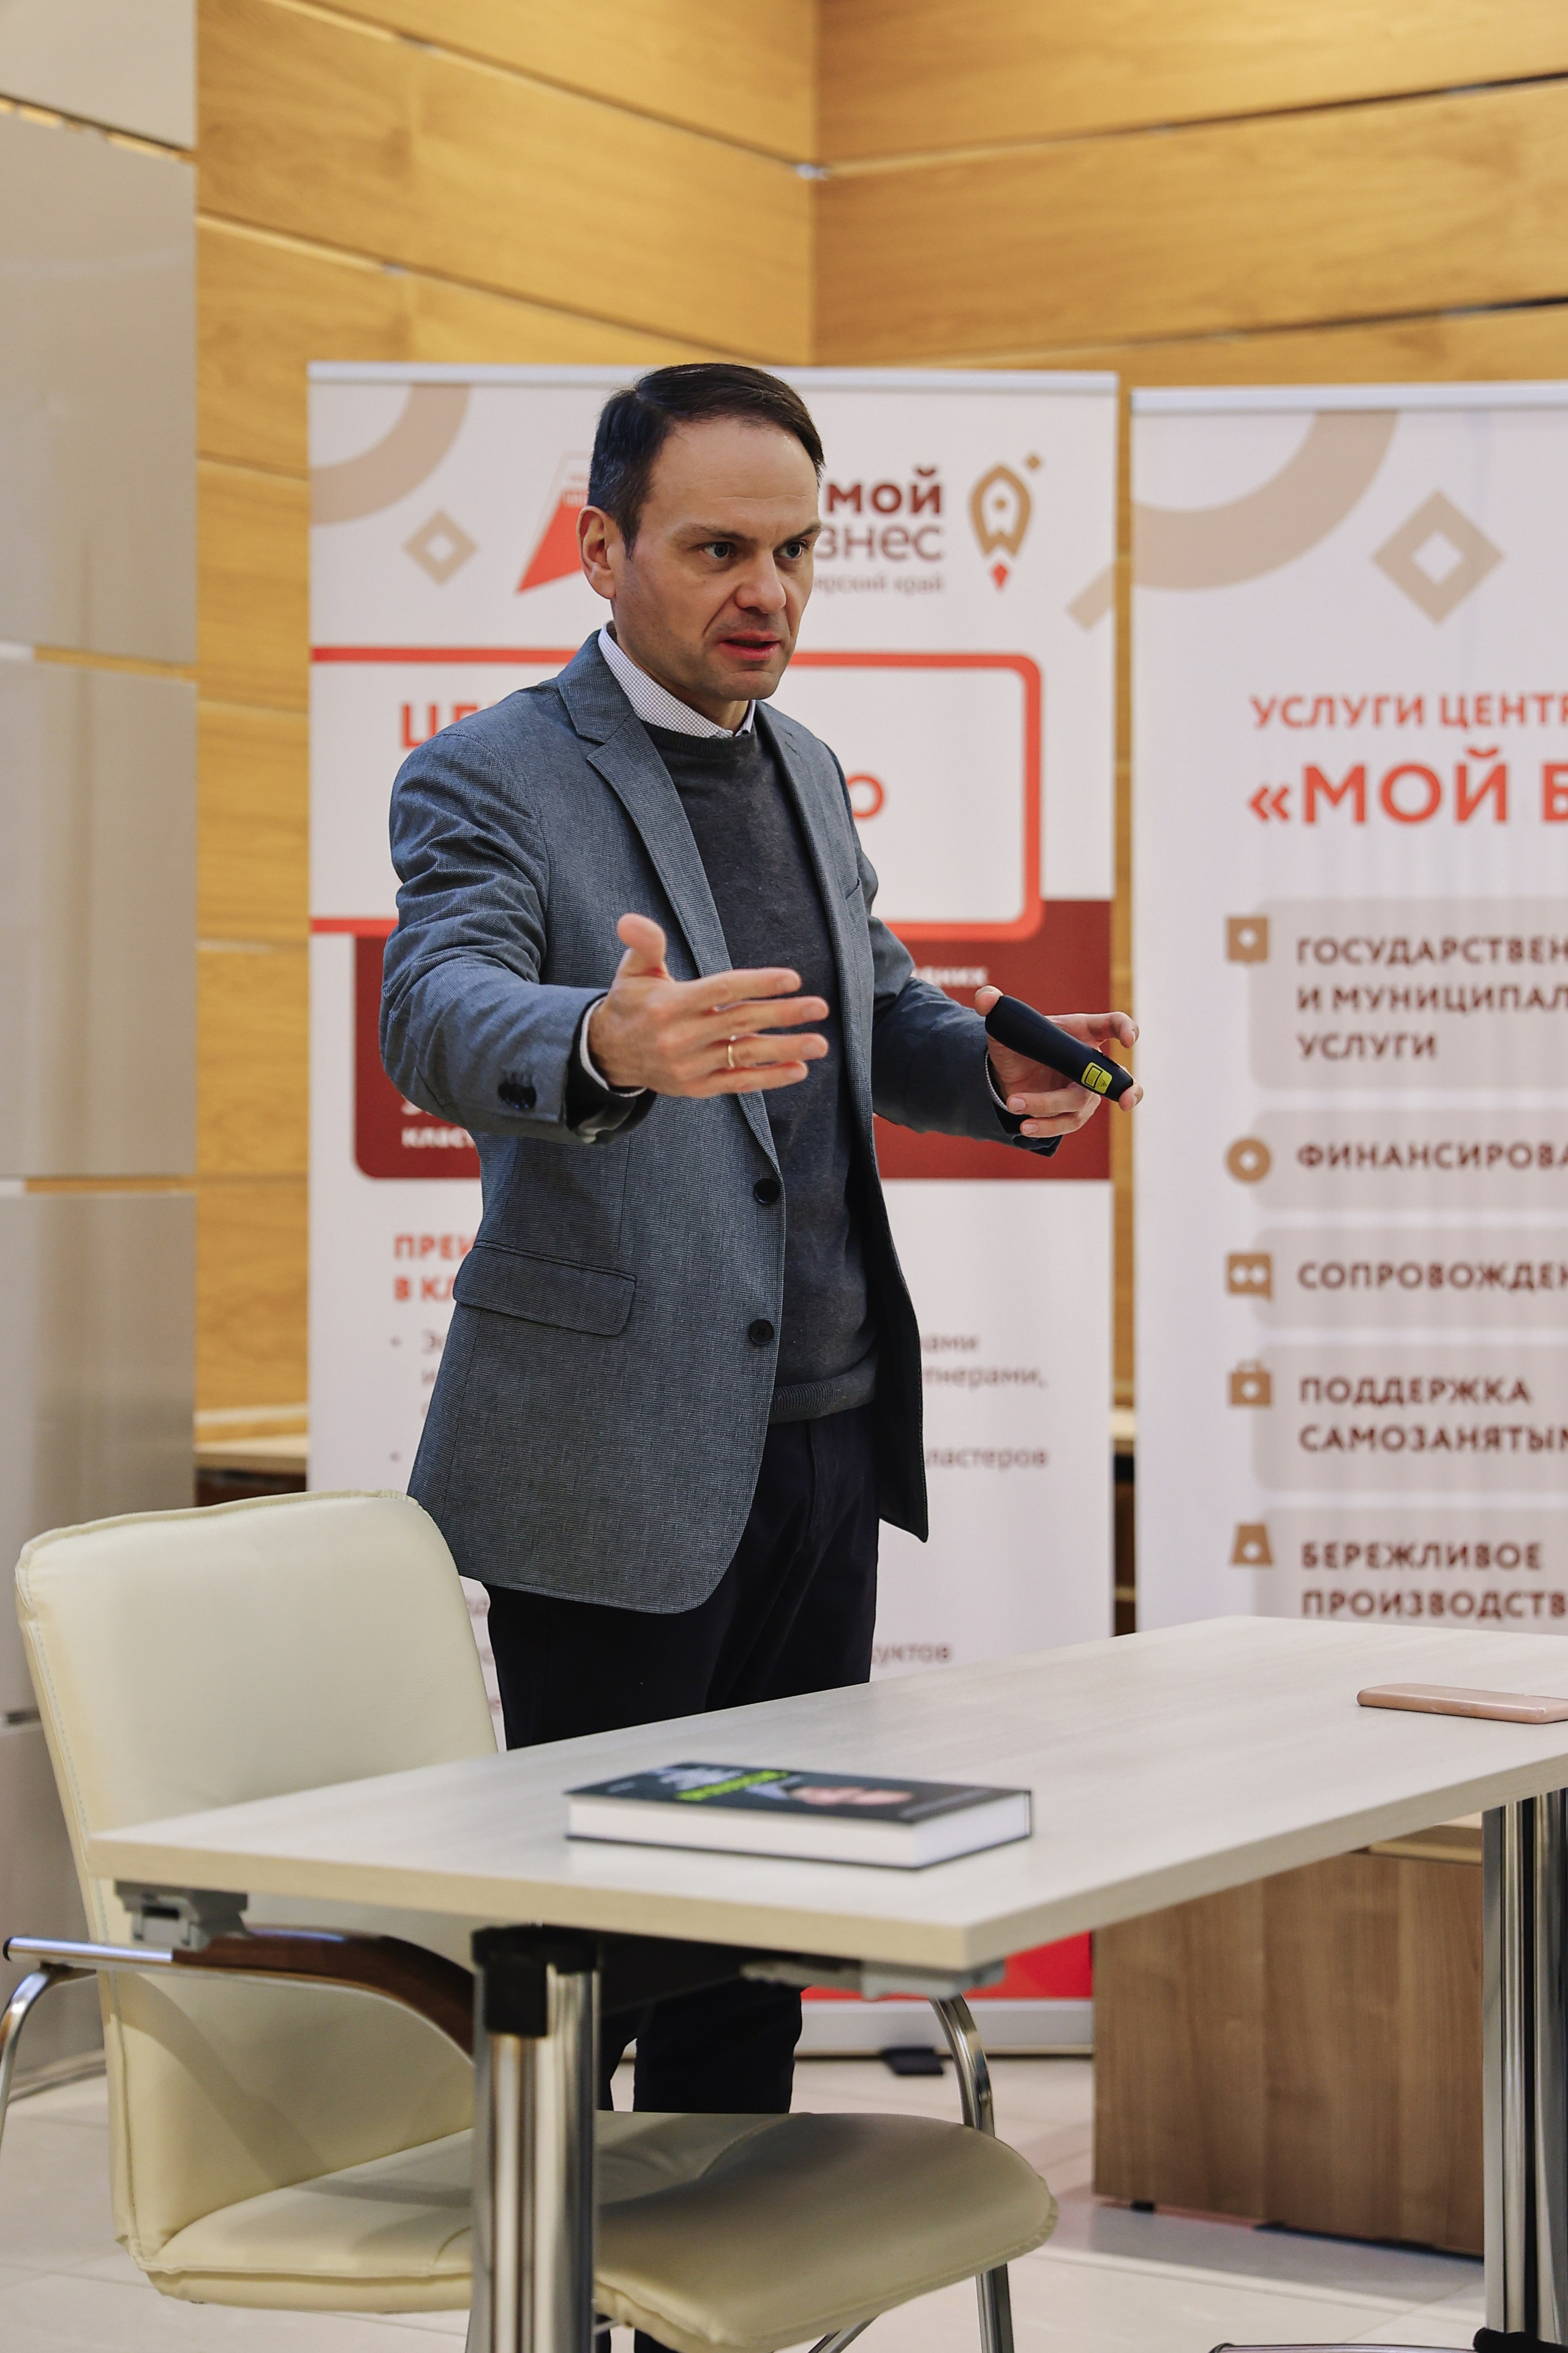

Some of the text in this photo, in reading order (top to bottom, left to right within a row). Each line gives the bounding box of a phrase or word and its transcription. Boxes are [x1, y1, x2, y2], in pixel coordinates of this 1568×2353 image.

[1250, 694, 1425, 728] УСЛУГИ
[1249, 746, 1508, 825] «МОЙ
[1297, 937, 1568, 967] ГОСУДАРСТВЕН
[1297, 985, 1568, 1014] И МУНИЦИПАЛ
[1297, 1032, 1437, 1061] УСЛУГИ
[1300, 1377, 1531, 1408] ПОДДЕРЖКА
[1302, 1542, 1541, 1570] БЕРЕЖЛИВОЕ
[1302, 1590, 1567, 1621] ПРОИЗВОДСТВ
